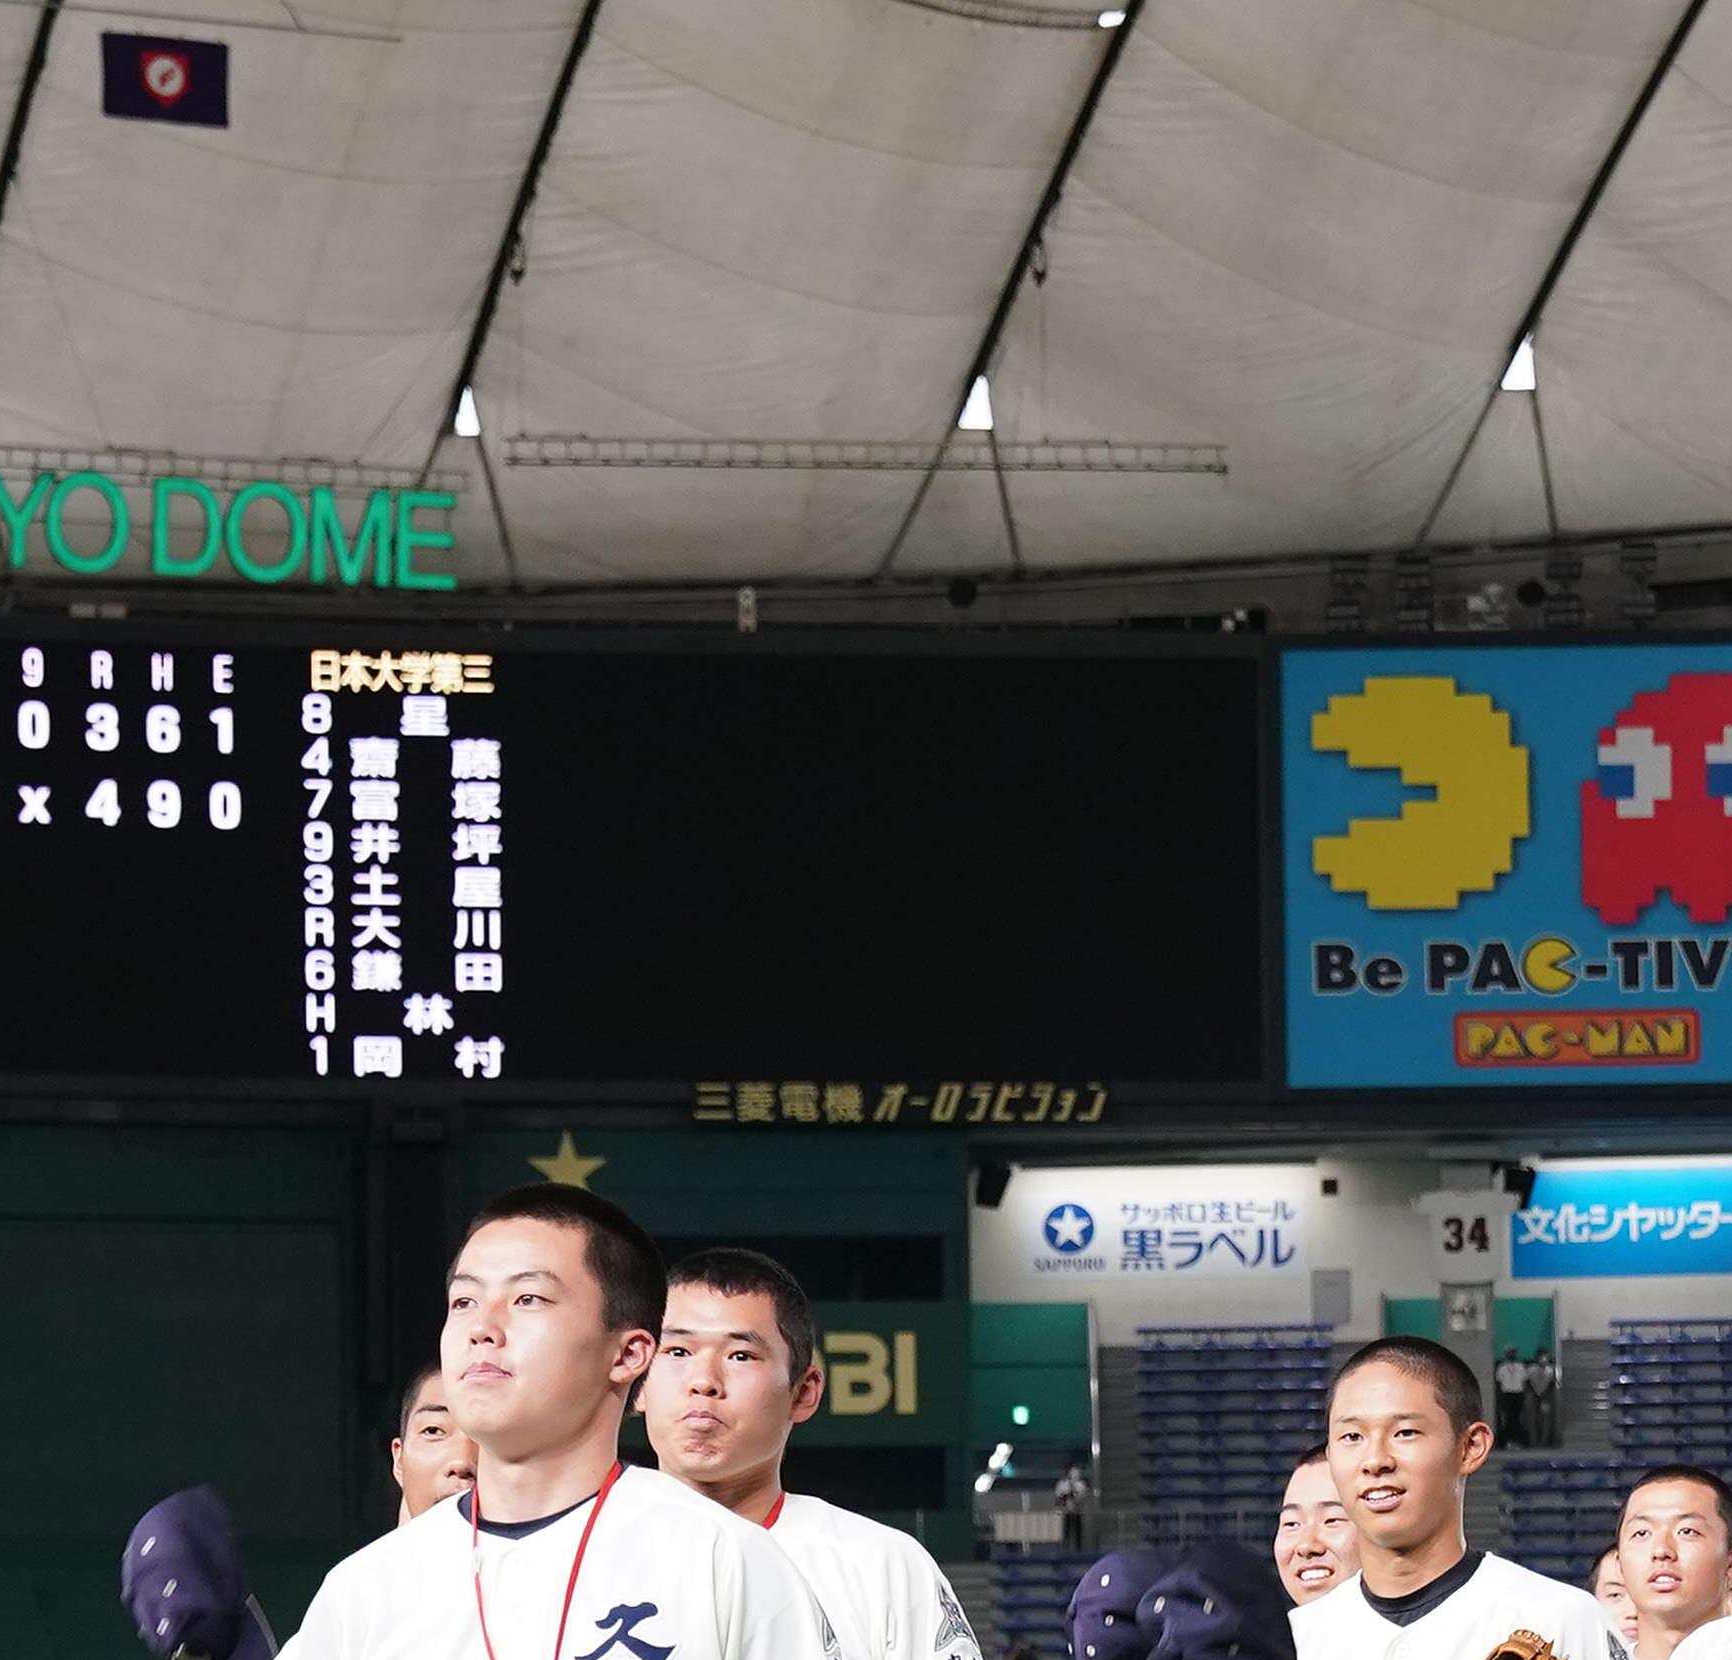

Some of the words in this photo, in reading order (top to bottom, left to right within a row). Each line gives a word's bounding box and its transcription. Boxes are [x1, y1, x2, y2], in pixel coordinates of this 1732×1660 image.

[154, 477, 457, 590] DOME
[21, 647, 44, 688] 9
[90, 650, 114, 690] R
[151, 653, 174, 692] H
[212, 654, 234, 694] E
[310, 649, 495, 695] 日本大学第三
[17, 700, 51, 749] 0
[85, 703, 120, 752] 3
[145, 704, 181, 754] 6
[209, 707, 234, 754] 1
[301, 693, 333, 735] 8
[399, 695, 450, 737] 星
[300, 736, 333, 777] 4
[85, 779, 122, 827] 4
[146, 779, 182, 829] 9
[209, 781, 242, 830] 0
[303, 778, 333, 819] 7
[303, 821, 334, 863] 9
[303, 863, 334, 905] 3
[304, 906, 335, 948] R
[351, 907, 502, 951] 大川
[304, 949, 336, 991] 6
[1312, 940, 1405, 996] Be
[305, 992, 336, 1033] H
[403, 993, 454, 1036] 林
[309, 1035, 329, 1076] 1
[1466, 1018, 1691, 1060] PAC-MAN
[693, 1081, 865, 1124] 三菱電機
[1121, 1228, 1296, 1271] 黒ラベル
[1443, 1216, 1490, 1254] 34
[813, 1331, 918, 1417] BI
